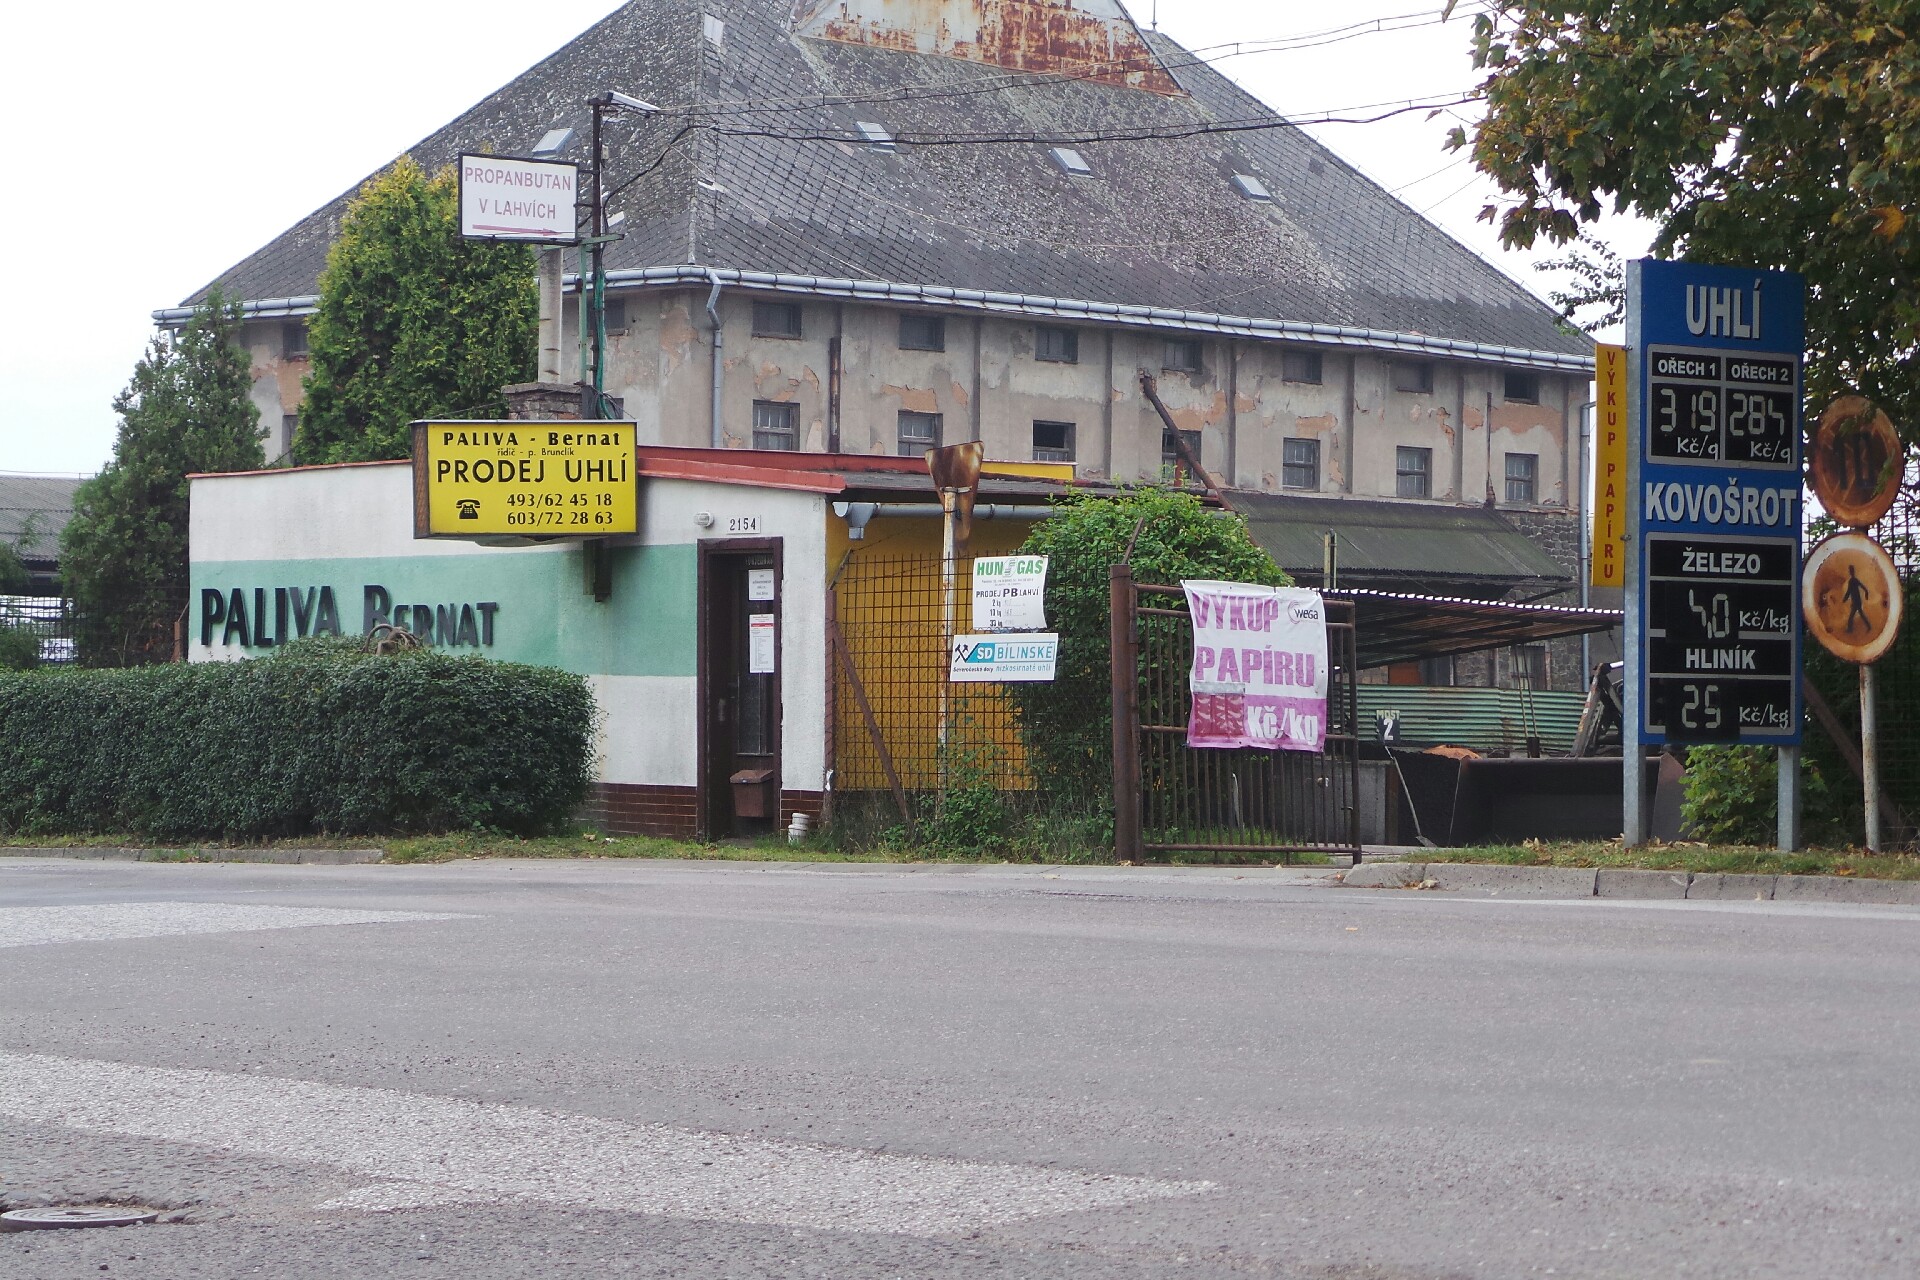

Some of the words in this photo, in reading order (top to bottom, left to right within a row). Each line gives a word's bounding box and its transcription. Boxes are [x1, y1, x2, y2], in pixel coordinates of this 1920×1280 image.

[465, 167, 571, 190] PROPANBUTAN
[479, 198, 488, 213] V
[495, 200, 556, 219] LAHVÍCH
[1686, 278, 1762, 340] UHLÍ
[1658, 357, 1705, 377] OŘECH
[1709, 364, 1716, 377] 1
[1731, 362, 1777, 381] OŘECH
[1781, 369, 1789, 382] 2
[1606, 351, 1616, 446] VÝKUP
[1660, 388, 1716, 433] 319
[1729, 392, 1785, 437] 284
[443, 432, 519, 446] PALIVA
[548, 432, 620, 446] Bernat
[528, 450, 536, 458] p.
[437, 459, 545, 483] PRODEJ
[565, 453, 627, 483] UHLÍ
[507, 493, 563, 508] 493/62
[569, 493, 588, 507] 45
[596, 493, 612, 507] 18
[1645, 477, 1797, 526] KOVOŠROT
[507, 512, 563, 527] 603/72
[570, 512, 589, 525] 28
[595, 512, 613, 525] 63
[729, 517, 756, 531] 2154
[1604, 463, 1616, 579] PAPÍRU
[1682, 546, 1761, 574] ŽELEZO
[976, 589, 1001, 598] PRODEJ
[1003, 588, 1018, 598] PB
[1020, 586, 1039, 597] LAHVÍ
[201, 585, 342, 646] PALIVA
[1739, 608, 1789, 635] Kč/kg
[976, 647, 993, 660] SD
[997, 642, 1053, 660] BÍLINSKÉ
[1685, 645, 1756, 670] HLINÍK
[1194, 645, 1315, 687] PAPÍRU
[1377, 709, 1400, 720] MOST
[1681, 684, 1721, 729] 25
[1739, 703, 1789, 730] Kč/kg
[1247, 705, 1318, 746] Kč/kg
[1383, 719, 1394, 740] 2
